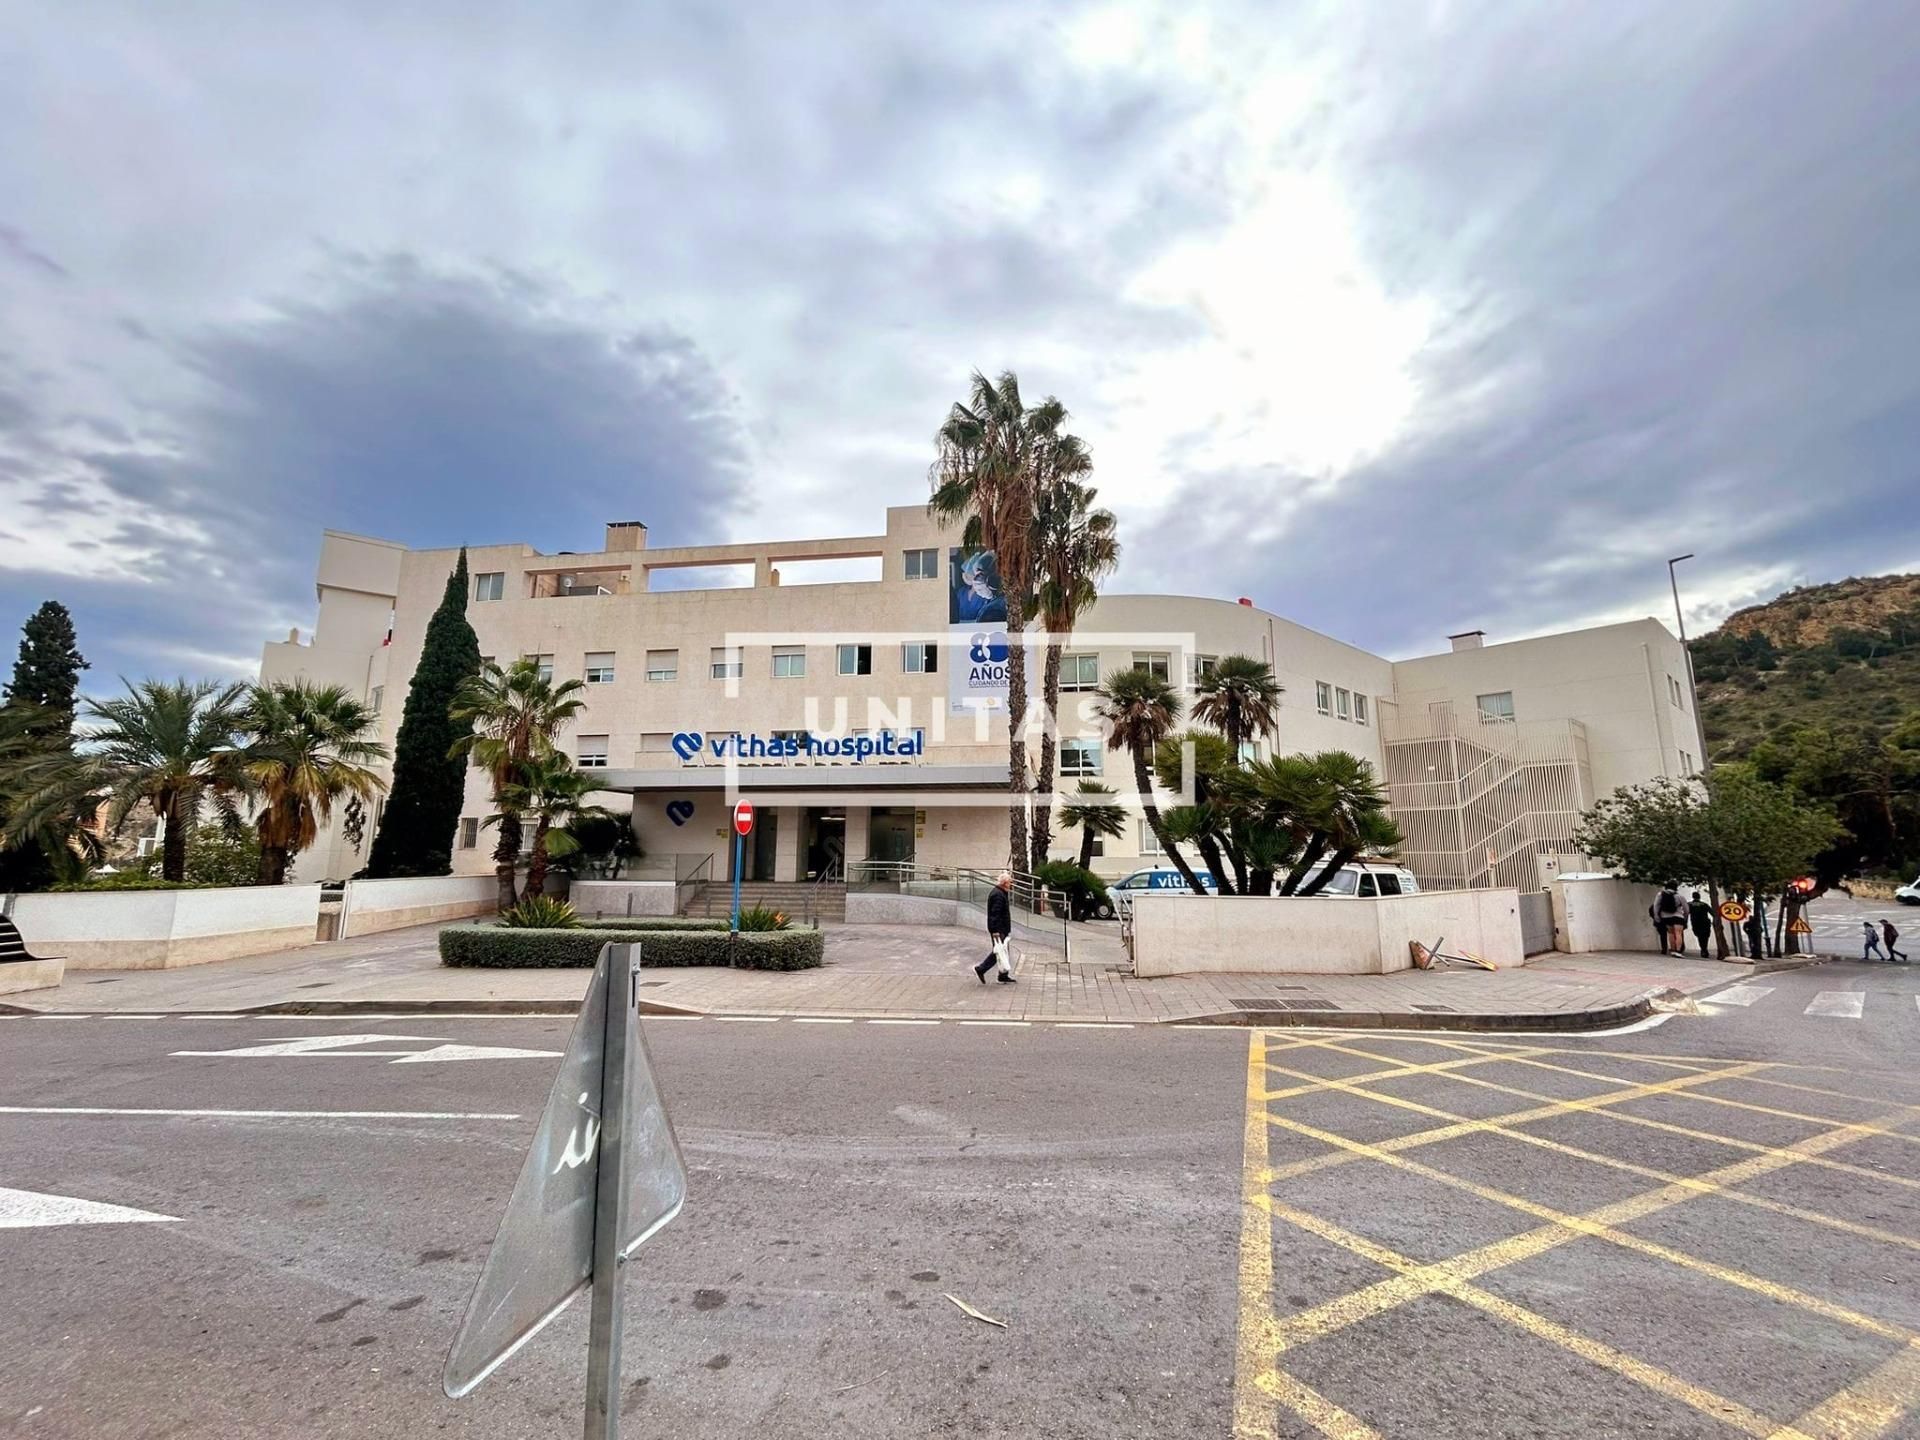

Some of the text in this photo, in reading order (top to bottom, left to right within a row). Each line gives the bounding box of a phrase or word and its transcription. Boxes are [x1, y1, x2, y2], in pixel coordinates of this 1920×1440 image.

[969, 664, 1011, 680] AÑOS
[710, 730, 922, 761] vithas hospital
[1157, 873, 1211, 888] viths
[1724, 906, 1742, 916] 20
